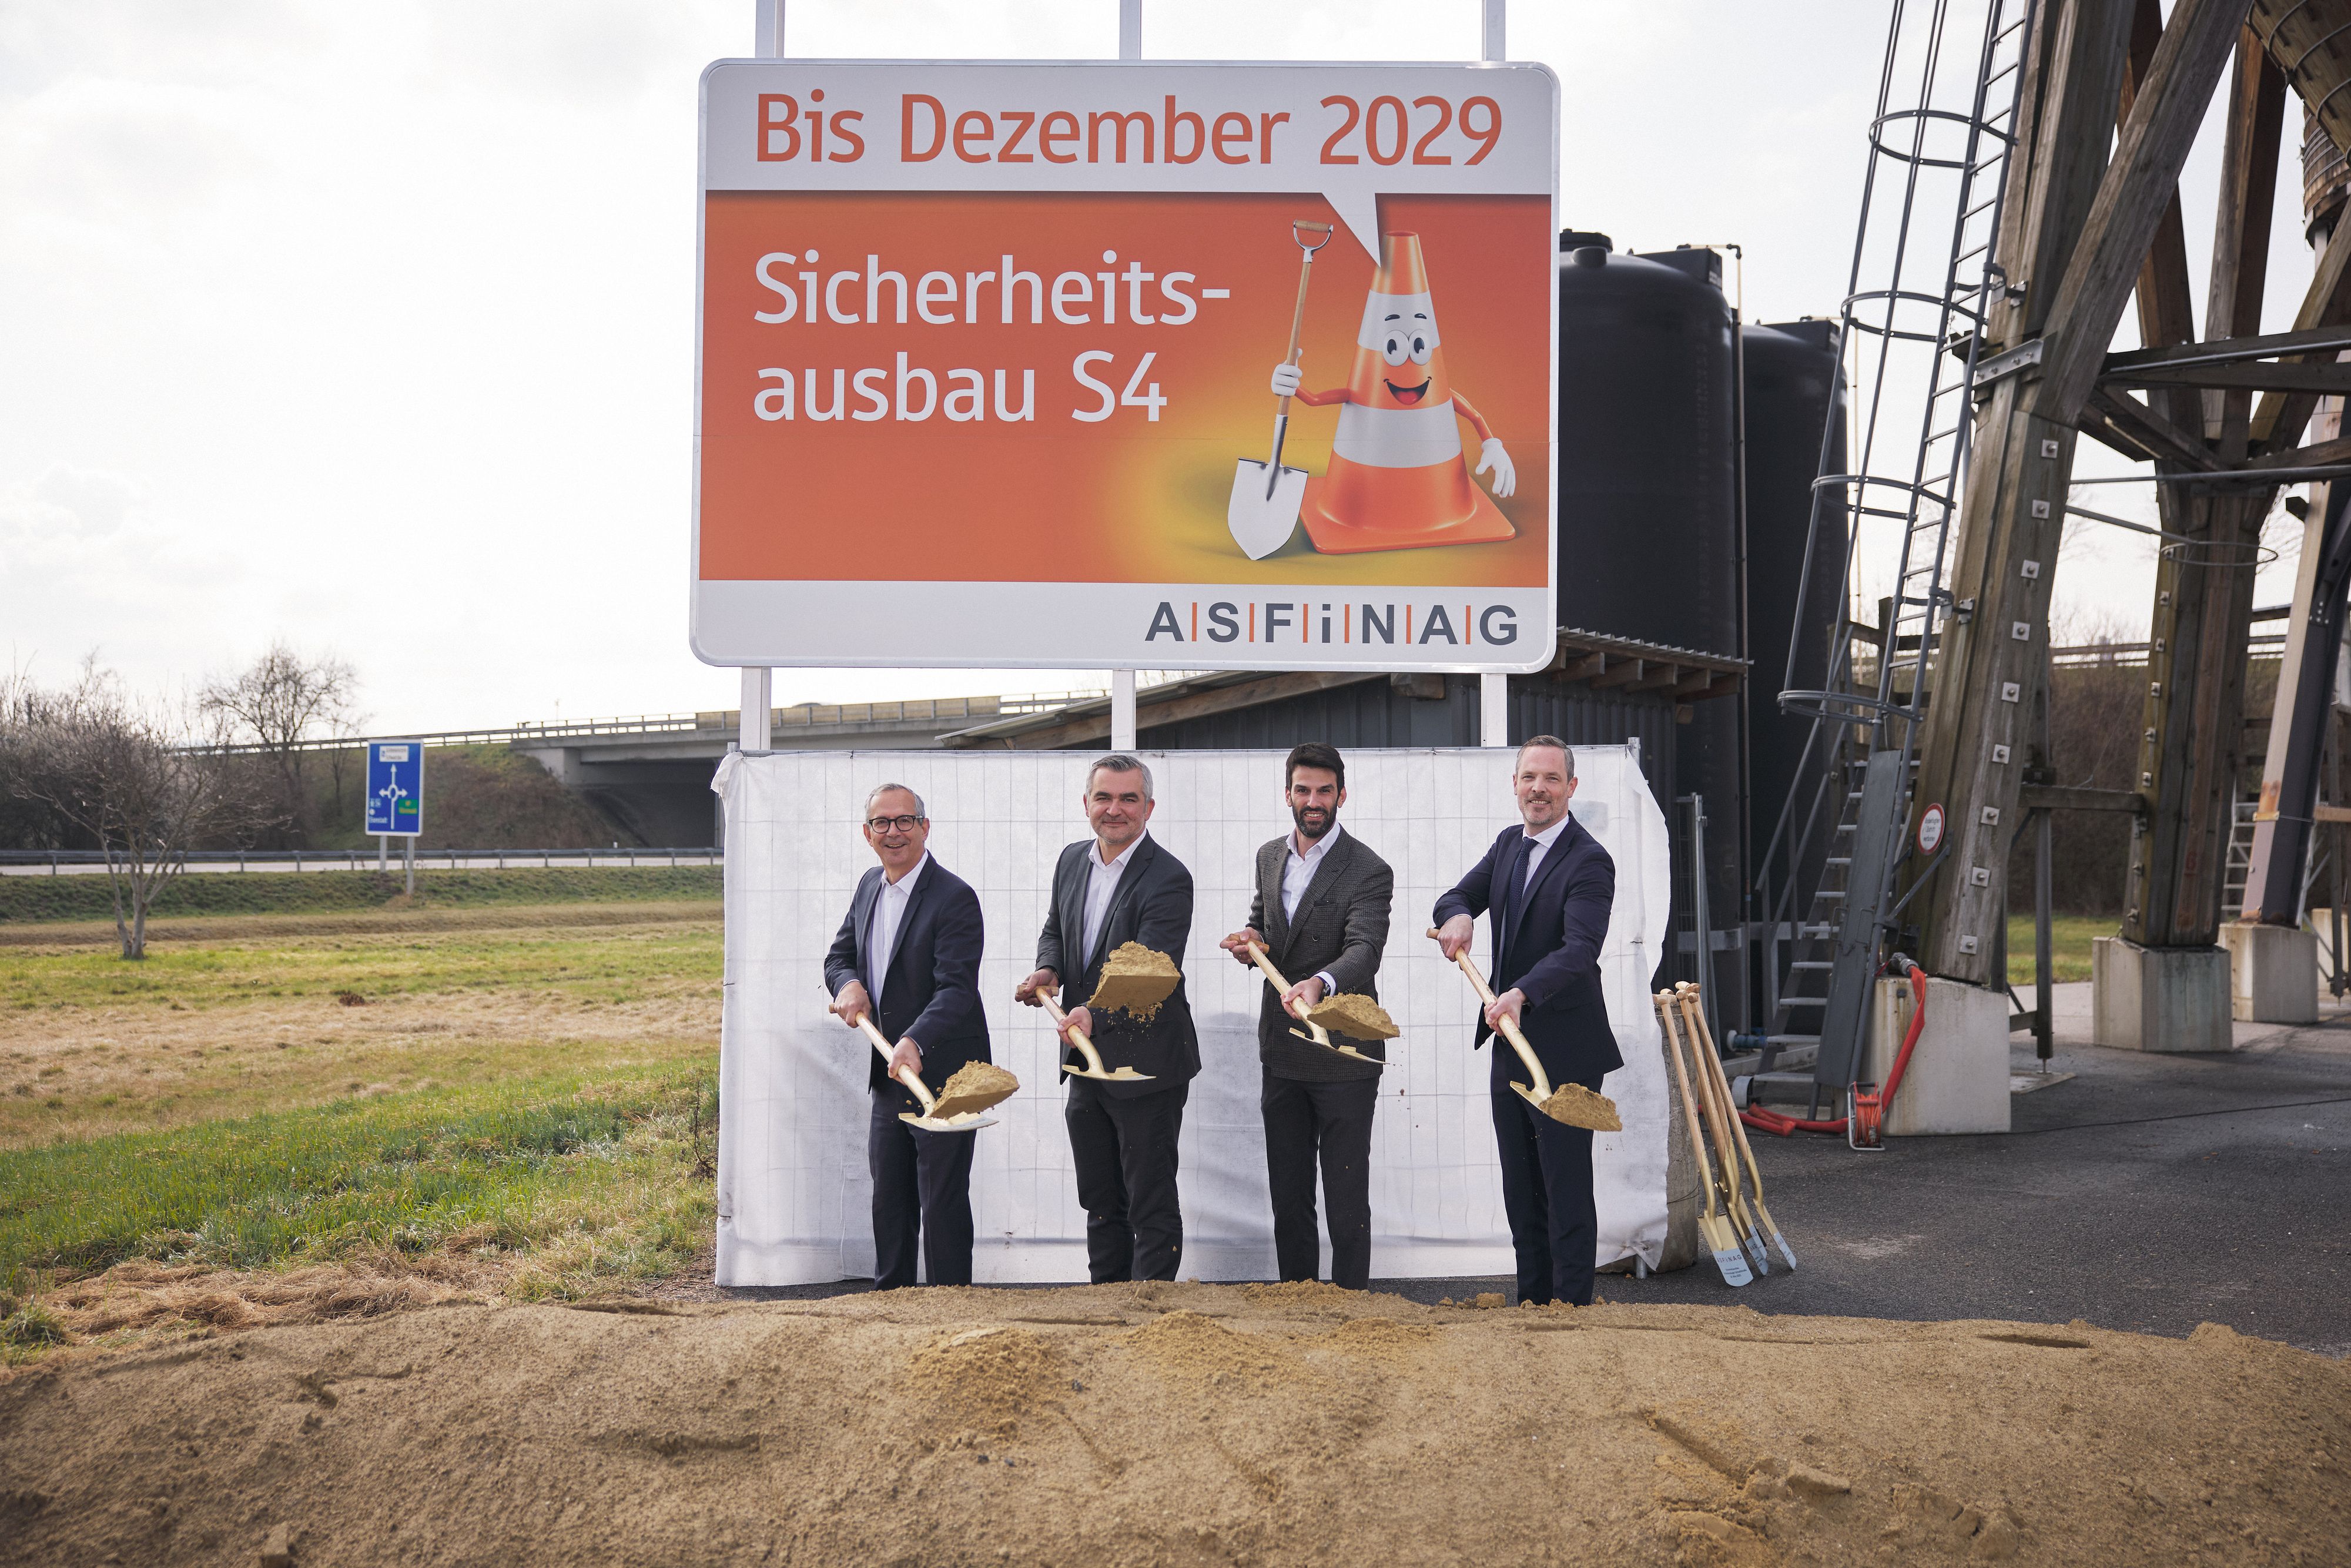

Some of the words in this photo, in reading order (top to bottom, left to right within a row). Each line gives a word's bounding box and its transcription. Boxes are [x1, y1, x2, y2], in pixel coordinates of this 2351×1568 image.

[758, 89, 865, 163] Bis
[901, 94, 1290, 165] Dezember
[1320, 95, 1502, 166] 2029
[753, 249, 1230, 326] Sicherheits-
[753, 351, 1035, 423] ausbau
[1071, 350, 1168, 423] S4
